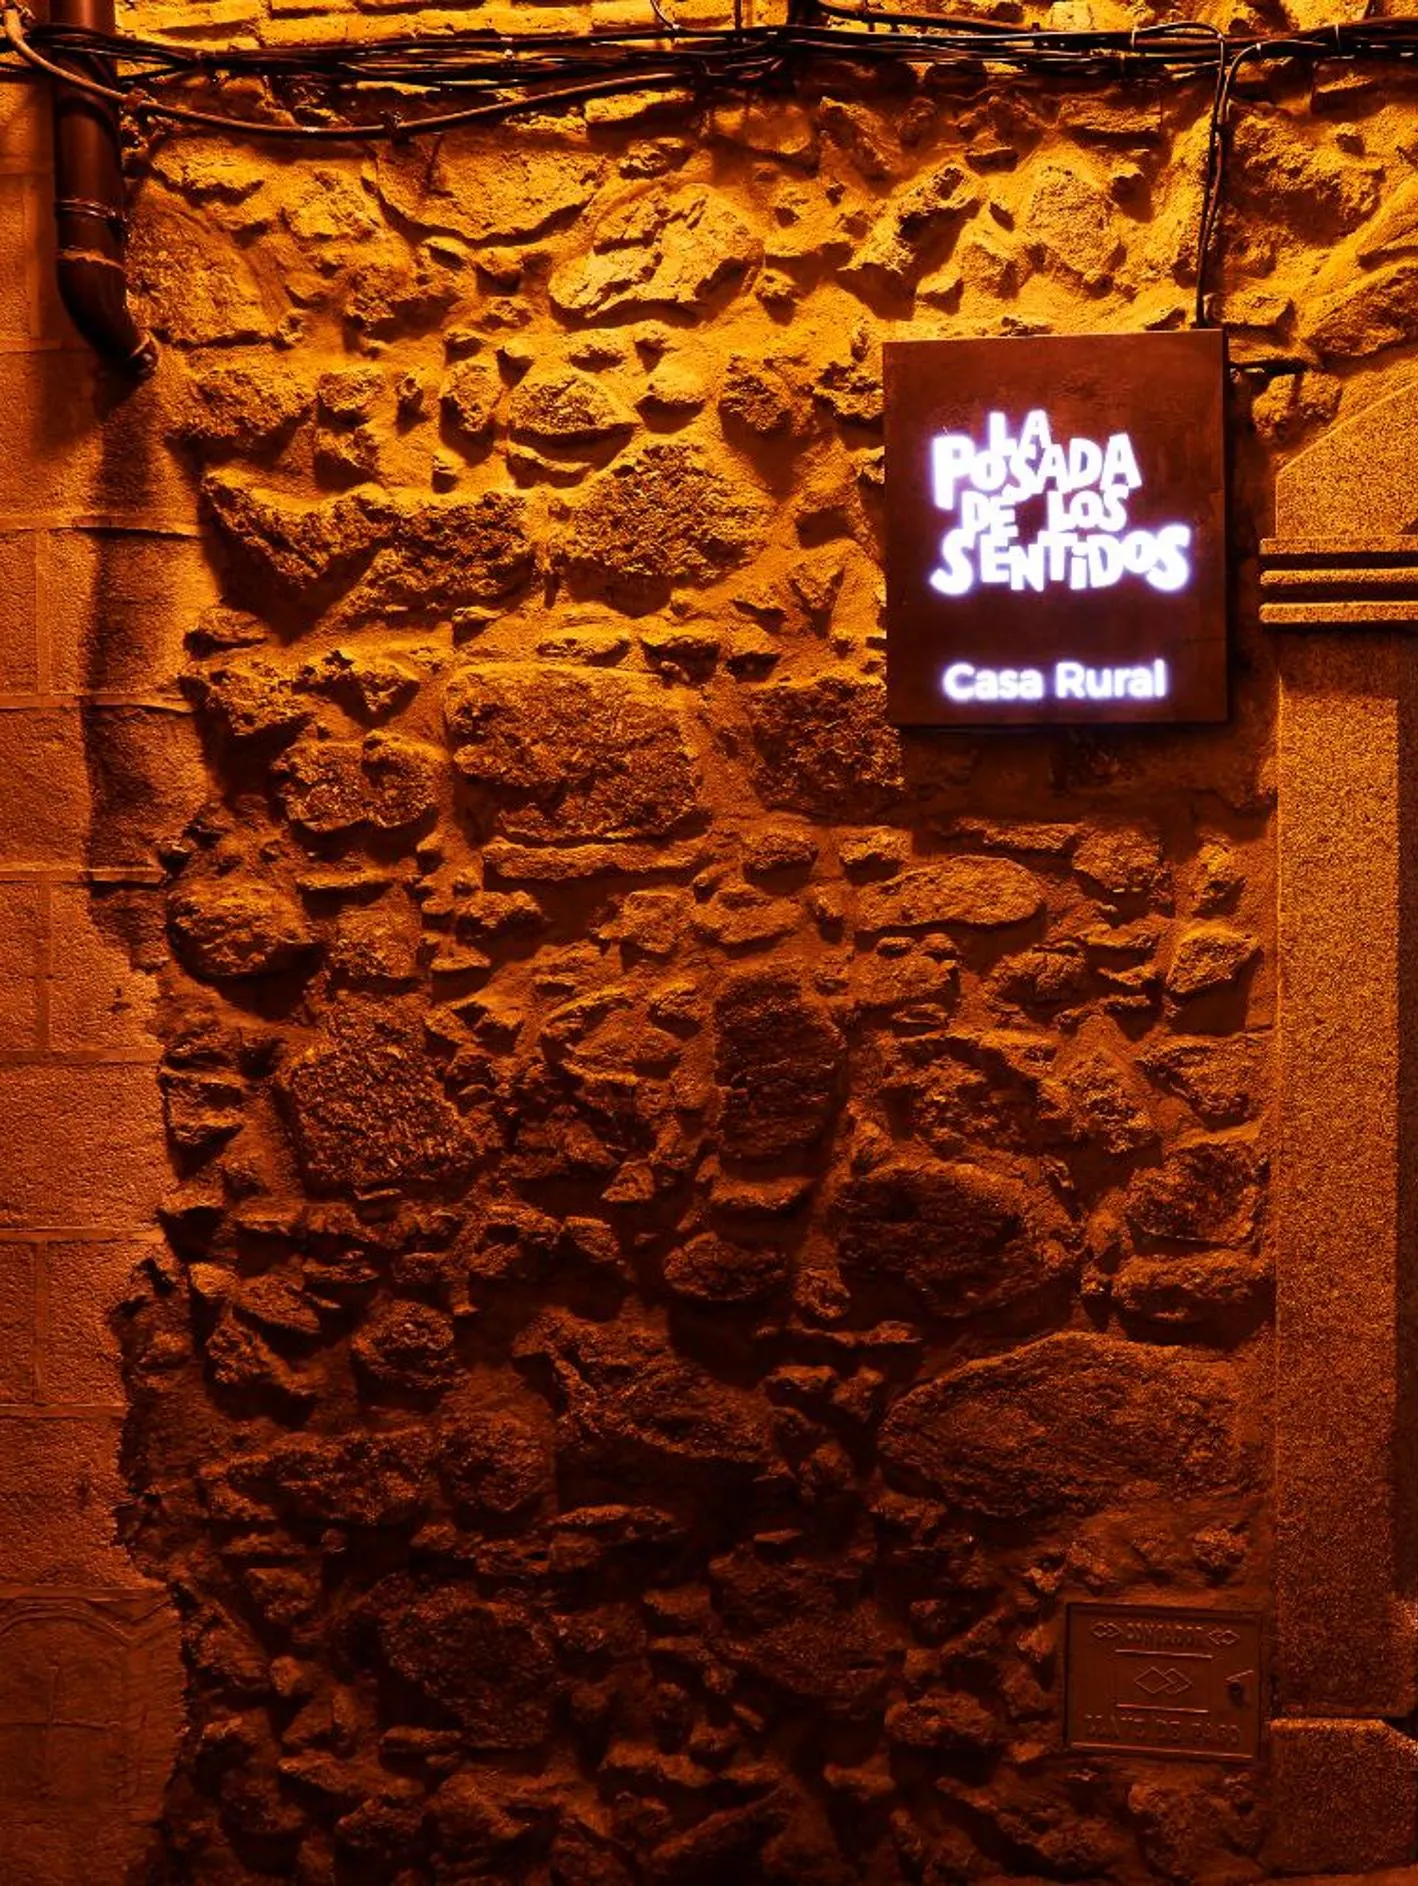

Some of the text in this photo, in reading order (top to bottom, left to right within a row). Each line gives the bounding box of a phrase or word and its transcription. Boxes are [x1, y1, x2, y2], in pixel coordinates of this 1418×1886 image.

[988, 409, 1051, 456] LA
[931, 434, 1143, 510] POSADA
[962, 485, 1130, 543] DE LOS
[943, 658, 1167, 700] Casa Rural
